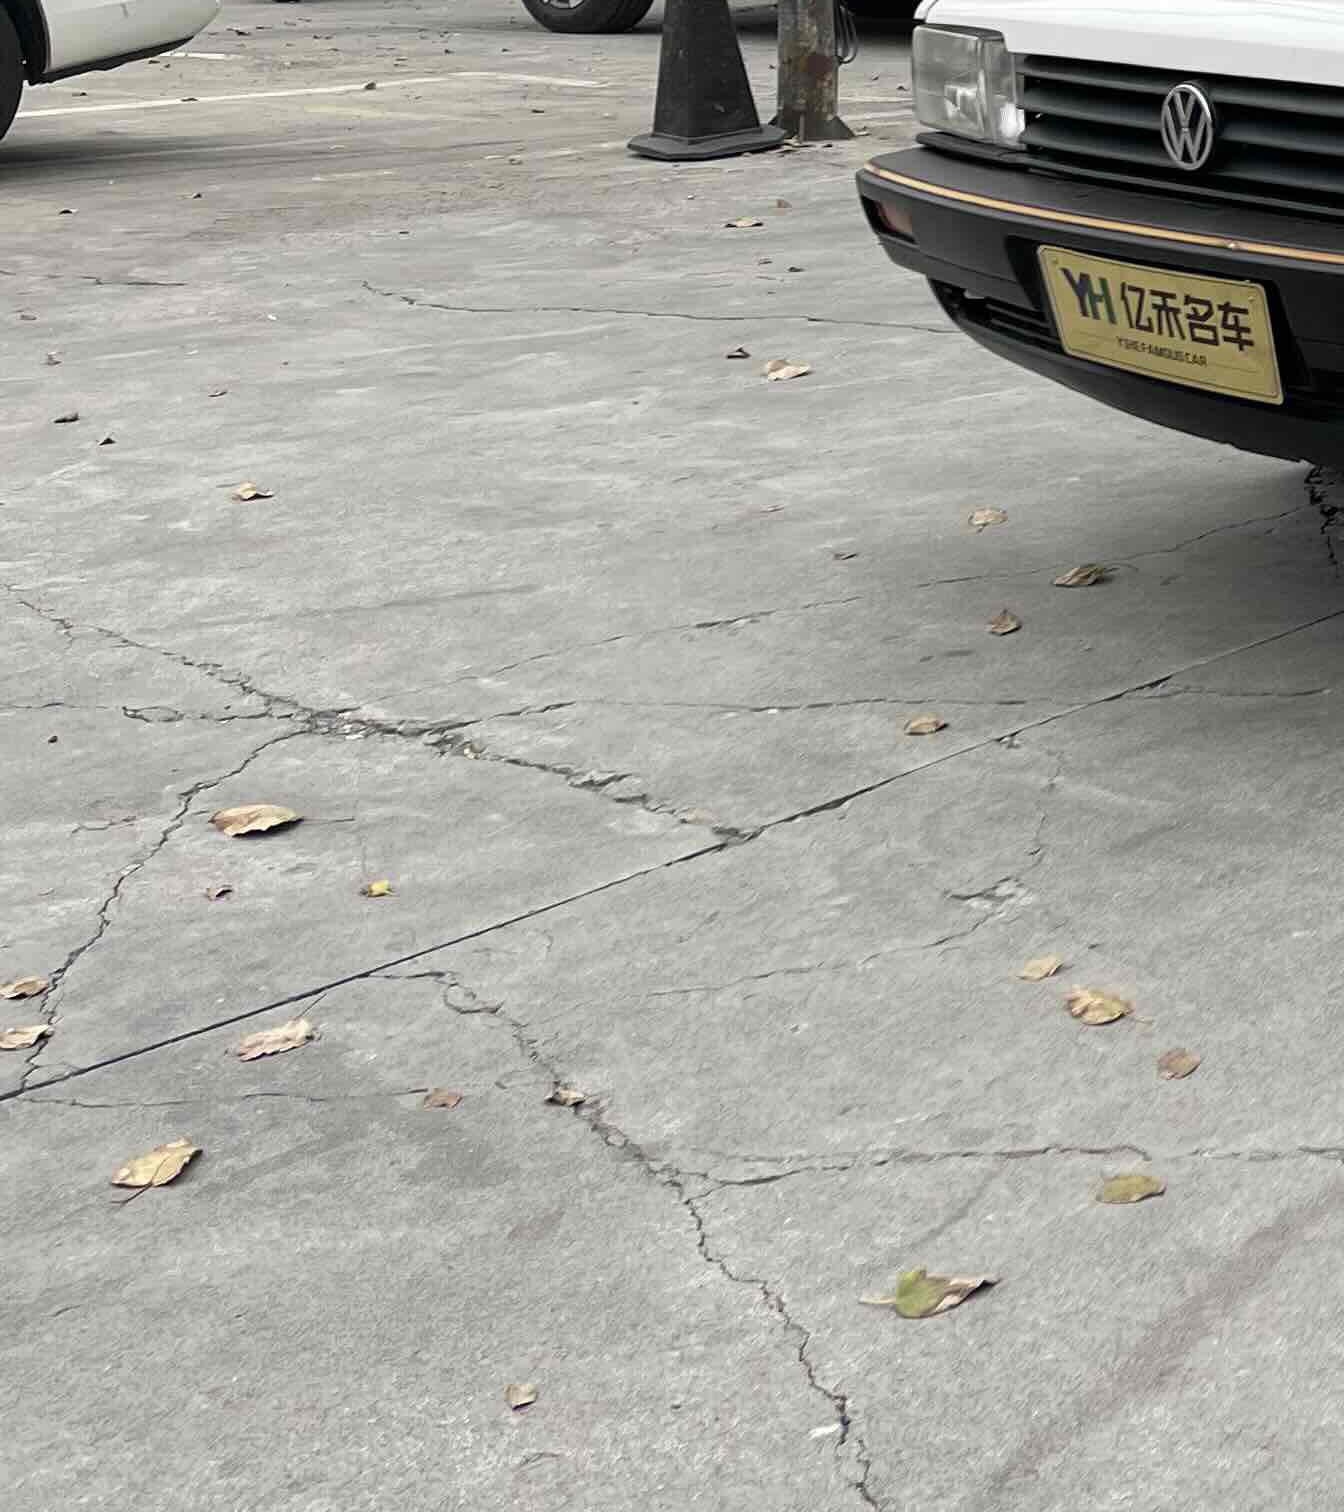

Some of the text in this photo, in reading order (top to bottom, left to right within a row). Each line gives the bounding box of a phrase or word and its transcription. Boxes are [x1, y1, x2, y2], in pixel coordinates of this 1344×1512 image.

[1060, 267, 1255, 352] YH 亿禾名车
